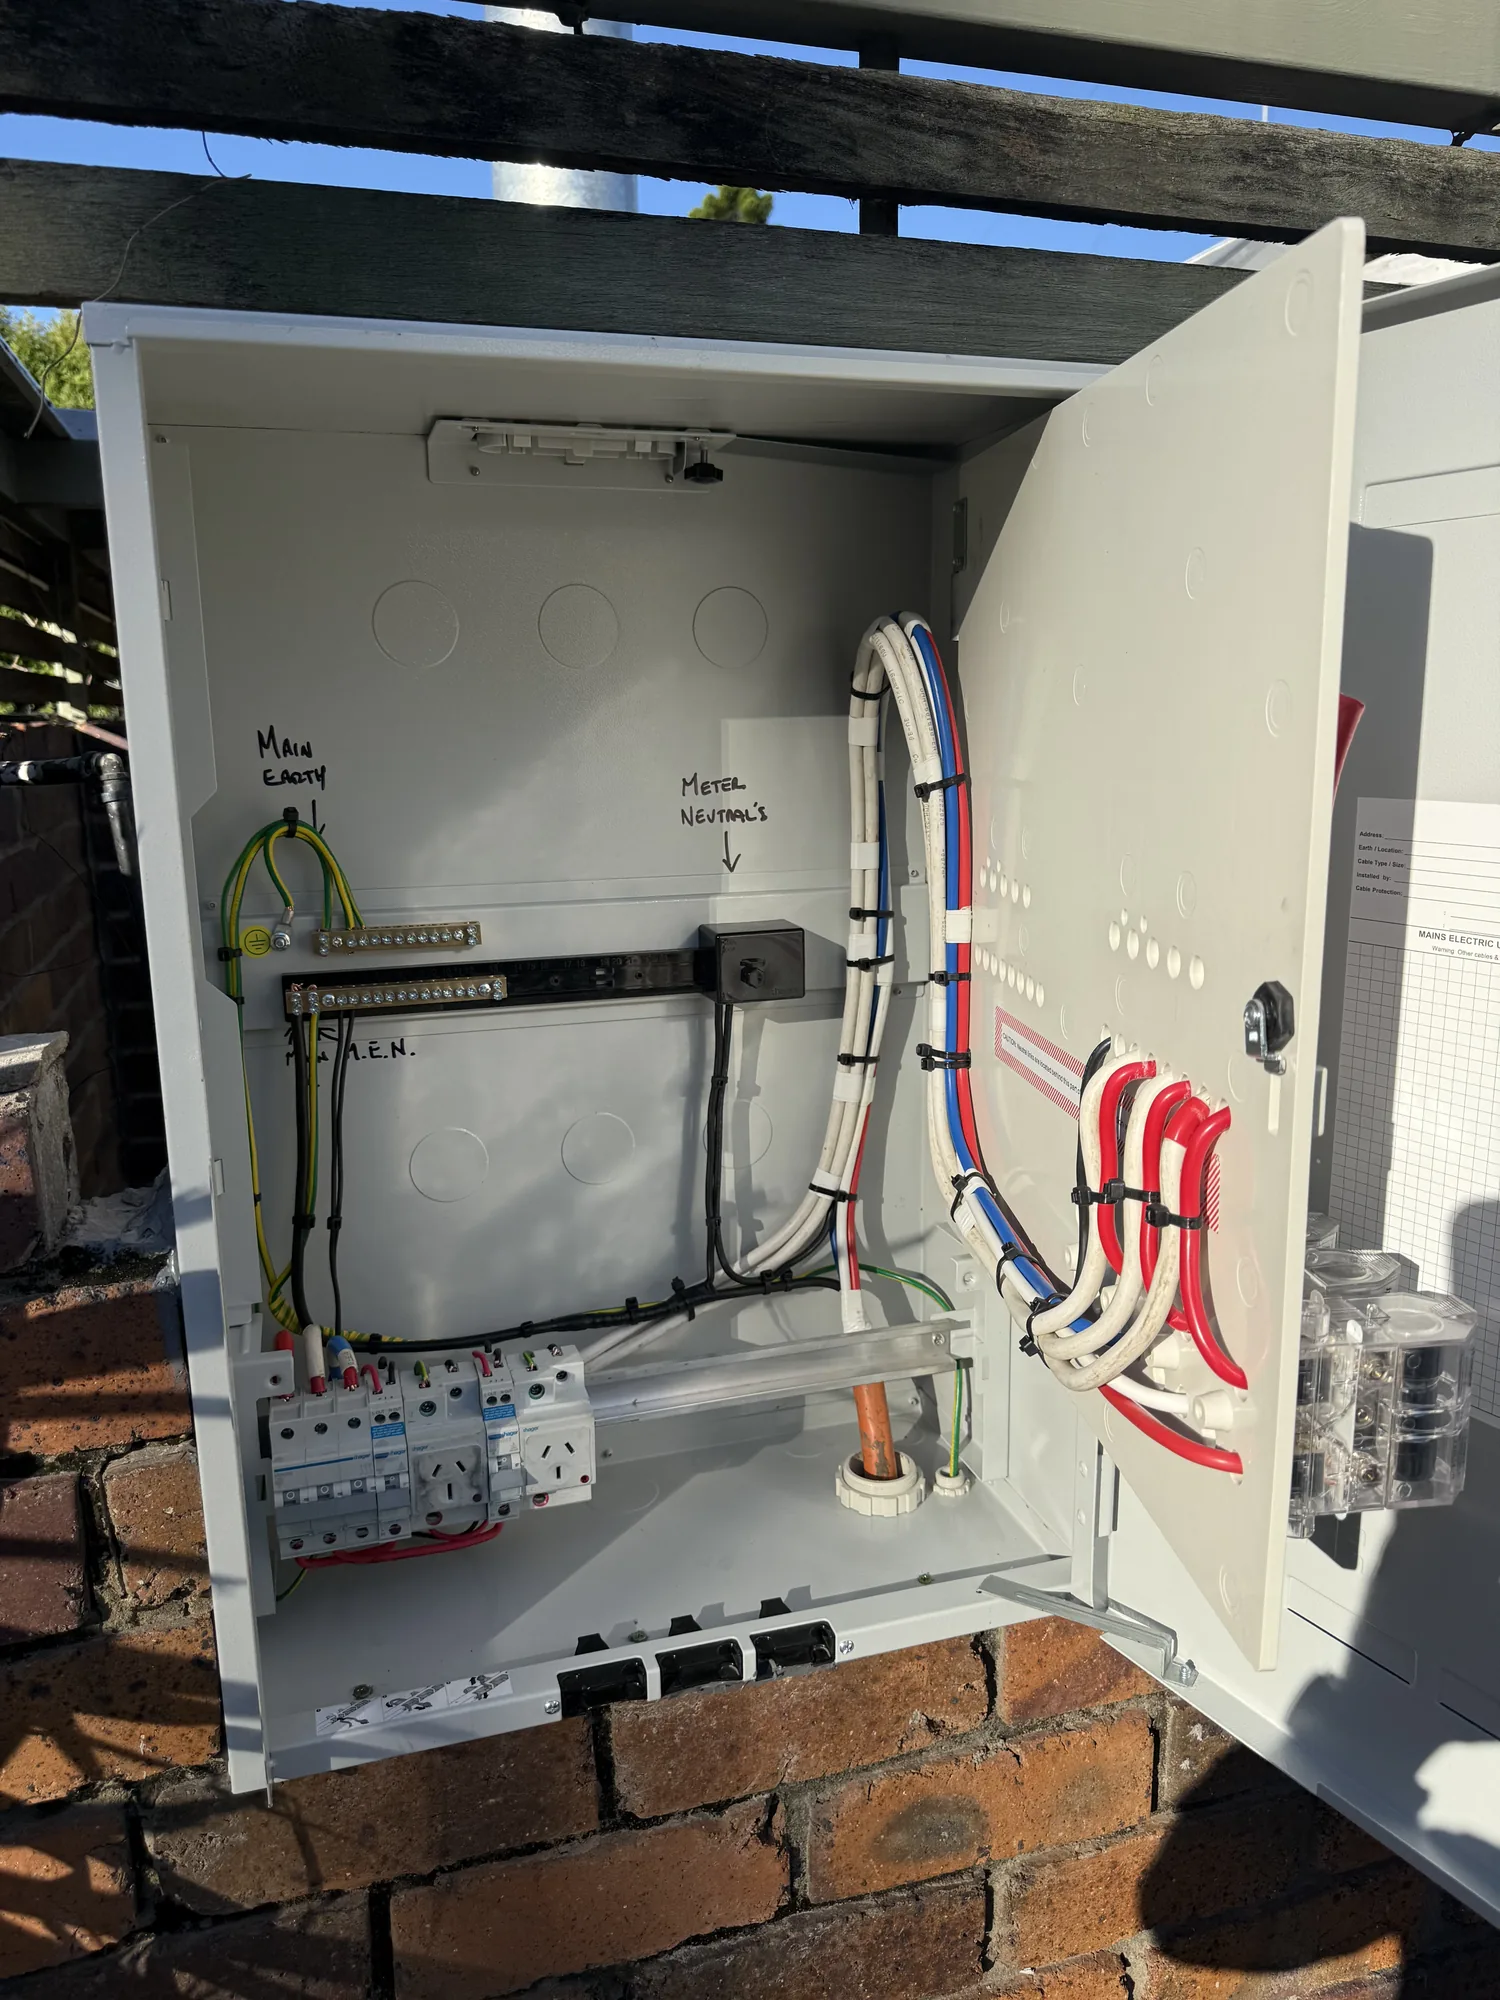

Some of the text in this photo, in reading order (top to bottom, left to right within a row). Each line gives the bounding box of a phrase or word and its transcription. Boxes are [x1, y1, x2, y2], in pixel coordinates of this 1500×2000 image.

[257, 724, 313, 759] MAIN
[263, 765, 326, 791] EARTH
[681, 772, 747, 797] METER
[681, 801, 768, 827] NEUTRAL'S
[1377, 846, 1404, 854] Location:
[1356, 872, 1392, 882] Installed by:
[1371, 887, 1403, 897] Protection:
[1418, 930, 1447, 941] MAINS
[1448, 934, 1494, 948] ELECTRIC
